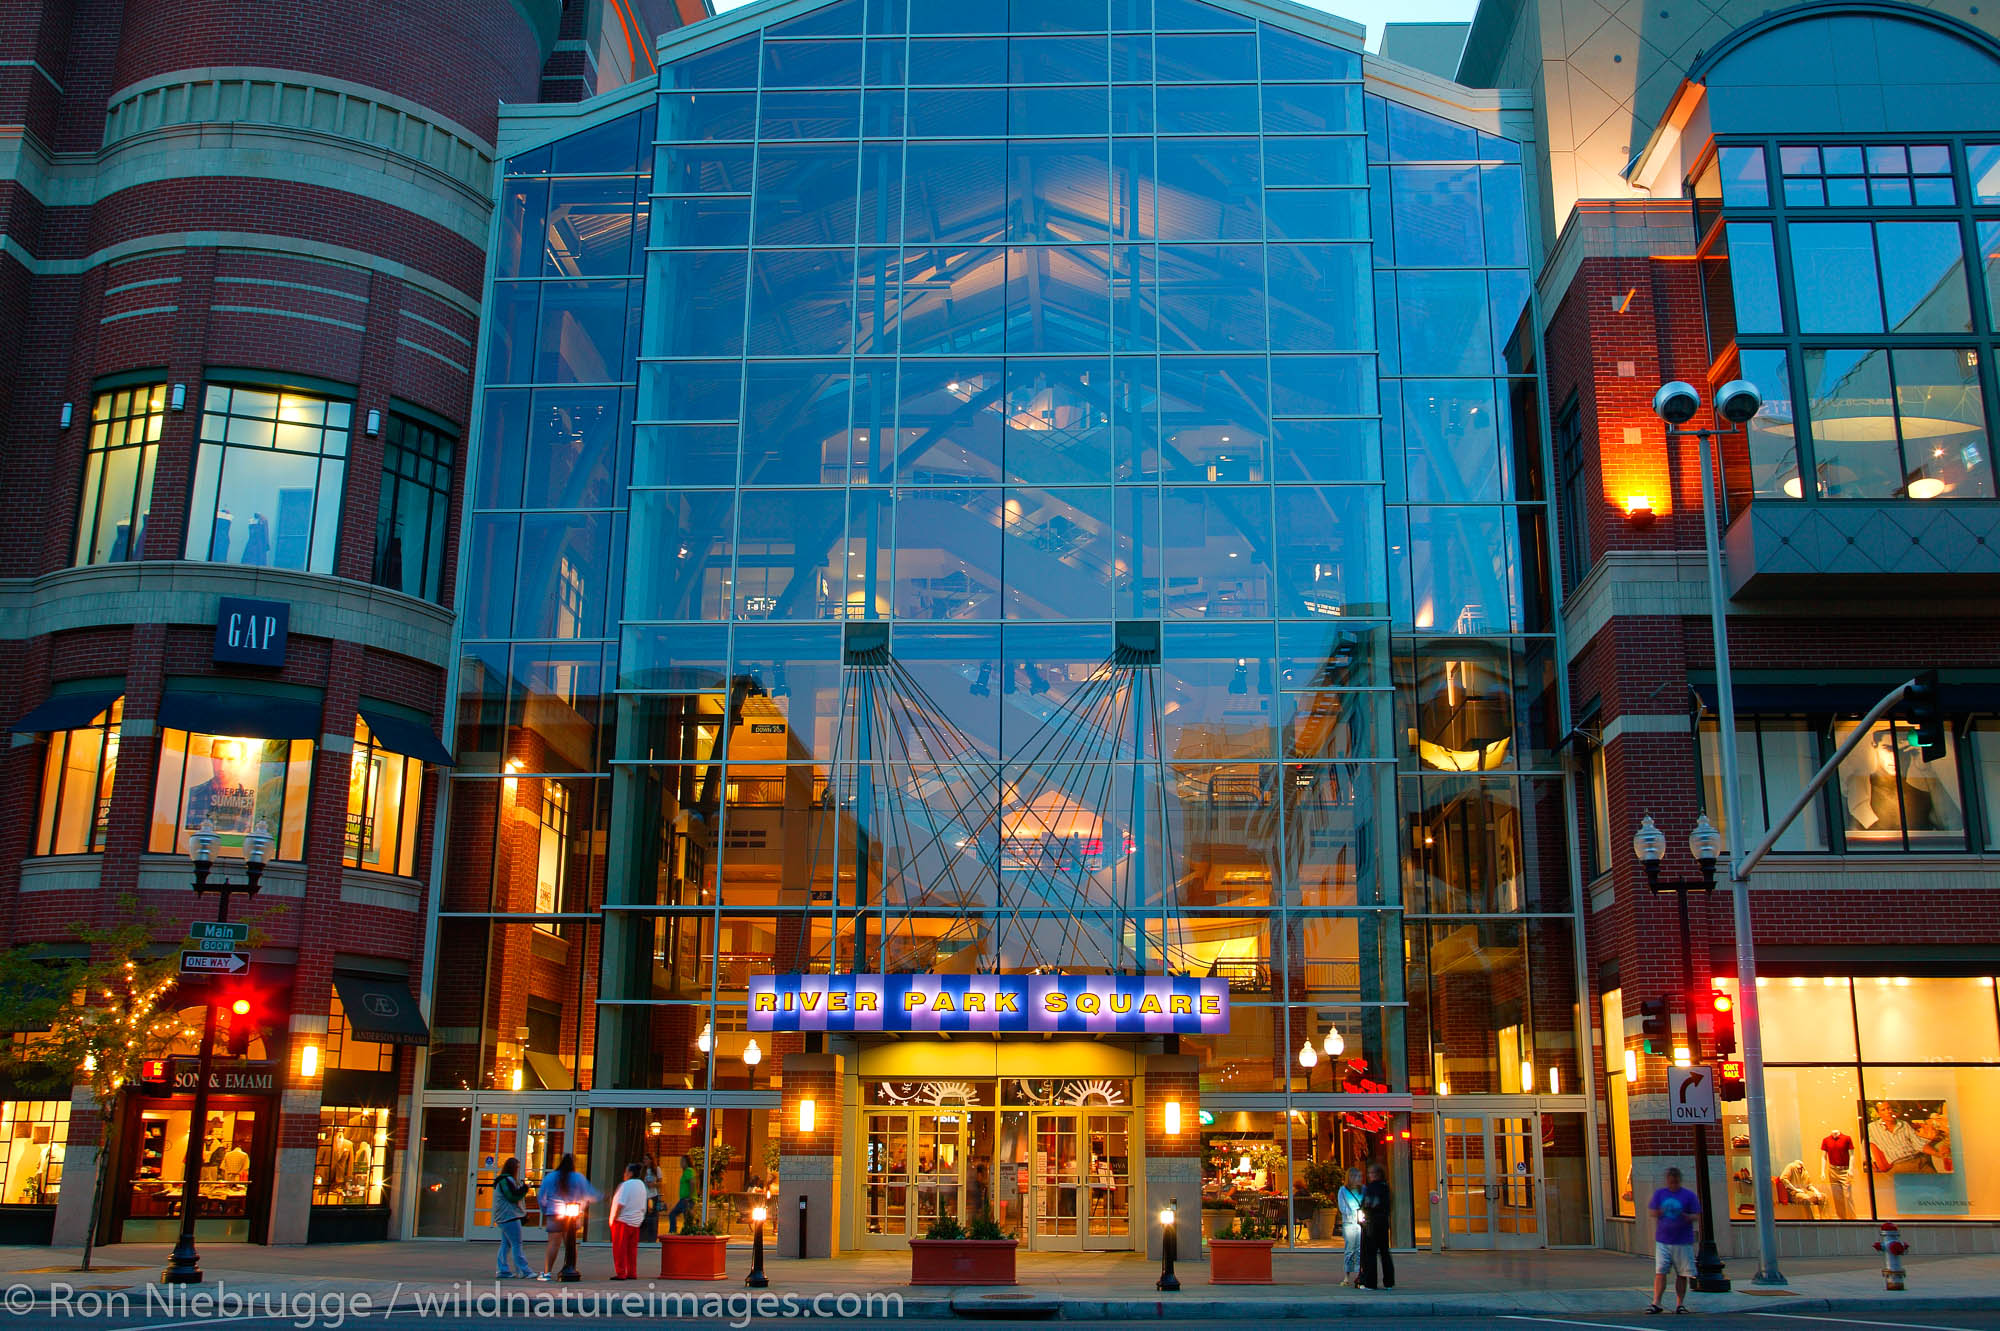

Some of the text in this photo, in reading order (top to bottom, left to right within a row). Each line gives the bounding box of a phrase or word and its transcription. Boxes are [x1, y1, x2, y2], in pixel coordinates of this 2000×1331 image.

[228, 613, 276, 650] GAP
[204, 924, 233, 938] Main
[188, 957, 230, 967] ONE WAY
[755, 991, 1221, 1016] RIVER PARK SQUARE
[208, 1073, 220, 1088] &
[225, 1074, 273, 1089] EMAMI
[1676, 1107, 1708, 1118] ONLY
